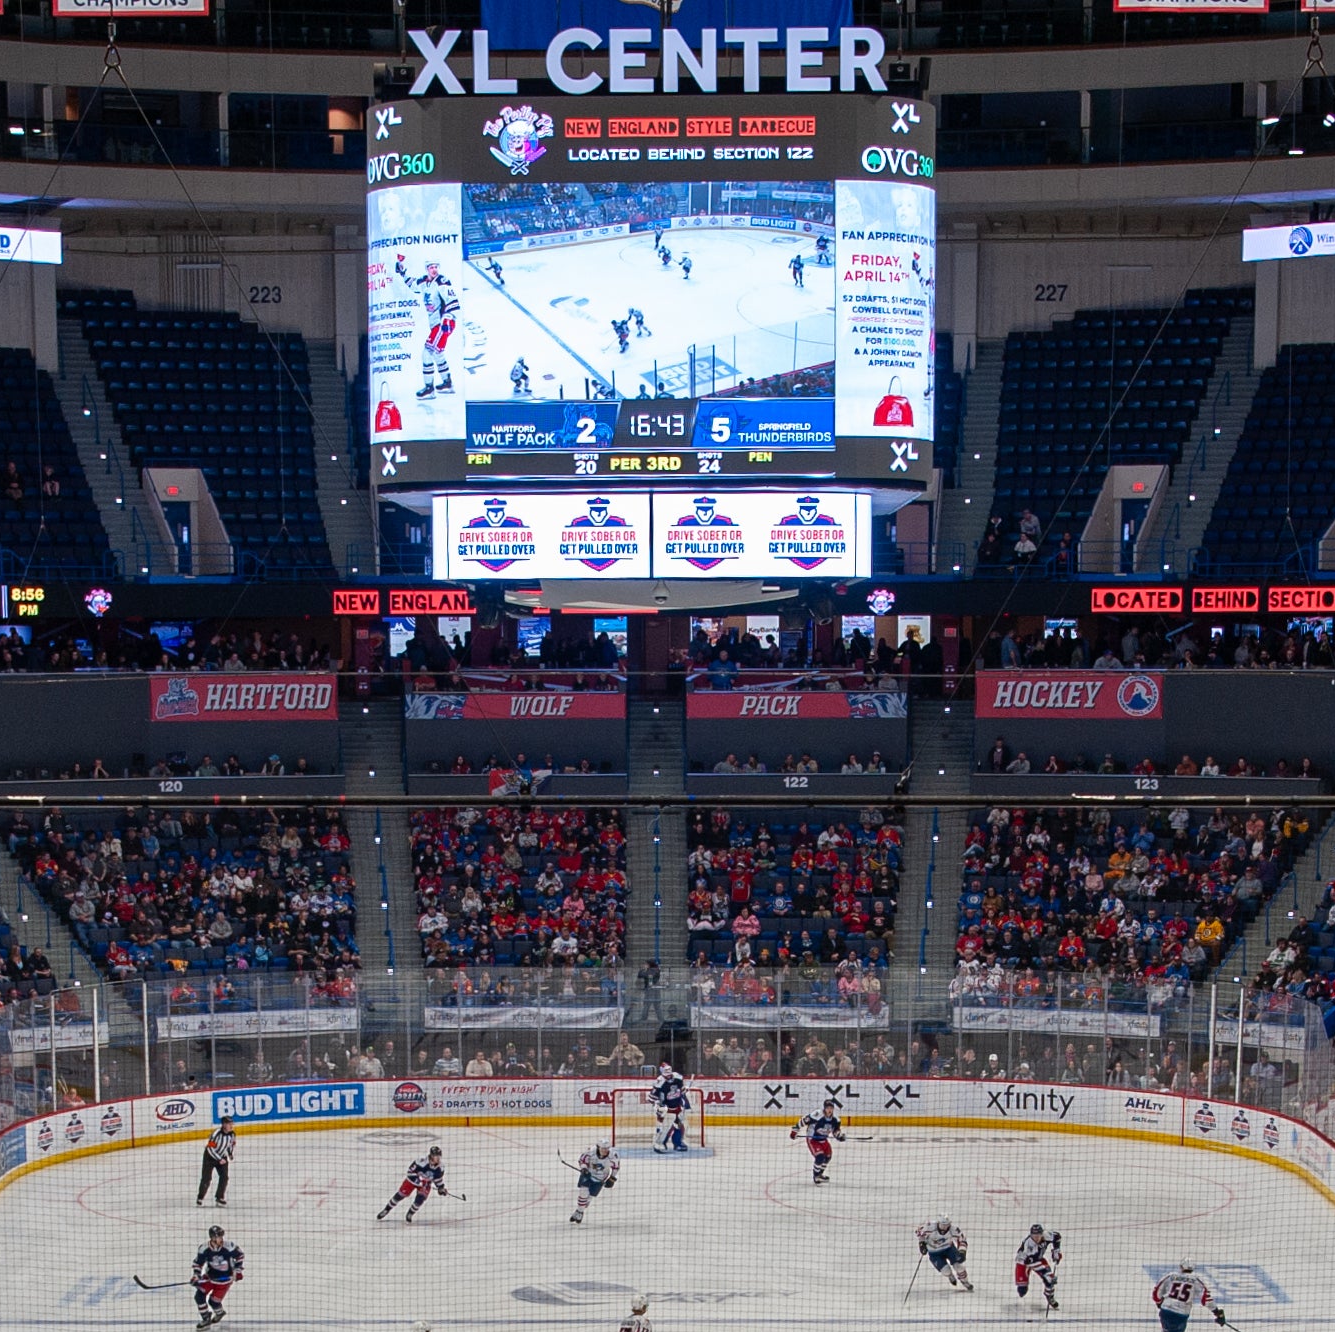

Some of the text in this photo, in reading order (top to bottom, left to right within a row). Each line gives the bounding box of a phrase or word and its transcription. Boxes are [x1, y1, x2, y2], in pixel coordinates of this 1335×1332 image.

[408, 27, 888, 95] XL CENTER
[566, 119, 814, 135] NEW ENGLAND STYLE BARBECUE
[569, 147, 814, 161] LOCATED BEHIND SECTION 122
[423, 233, 459, 245] NIGHT
[842, 231, 928, 246] FAN APPRECIATION
[852, 254, 902, 268] FRIDAY,
[844, 270, 886, 282] APRIL
[249, 285, 283, 305] 223
[1034, 283, 1068, 303] 227
[576, 418, 597, 443] 2
[630, 414, 685, 436] 16:43
[710, 417, 731, 442] 5
[472, 433, 556, 445] WOLF PACK
[737, 431, 832, 443] THUNDERBIRDS
[468, 454, 492, 465] PEN
[610, 456, 682, 471] PER 3RD
[748, 452, 773, 463] PEN
[575, 461, 597, 474] 20
[698, 459, 721, 473] 24
[459, 531, 533, 543] DRIVE SOBER OR
[562, 531, 636, 542] DRIVE SOBER OR
[668, 530, 742, 541] DRIVE SOBER OR
[458, 544, 535, 556] GET PULLED OVER
[560, 543, 638, 555] GET PULLED OVER
[666, 543, 744, 554] GET PULLED OVER
[11, 587, 45, 602] 8:56
[1093, 591, 1181, 609] LOCATED
[1193, 591, 1258, 609] BEHIND
[334, 594, 378, 611] NEW
[19, 604, 39, 616] PM
[204, 682, 333, 712] HARTFORD
[992, 680, 1104, 710] HOCKEY
[509, 695, 574, 716] WOLF
[738, 694, 803, 716] PACK
[158, 780, 183, 793] 120
[783, 776, 809, 789] 122
[1133, 778, 1161, 791] 123
[163, 1102, 188, 1116] AHL
[217, 1089, 355, 1118] BUD LIGHT
[432, 1099, 552, 1109] $2 DRAFTS $1 HOT DOGS
[986, 1085, 1075, 1119] xfinity
[1169, 1283, 1193, 1301] 55
